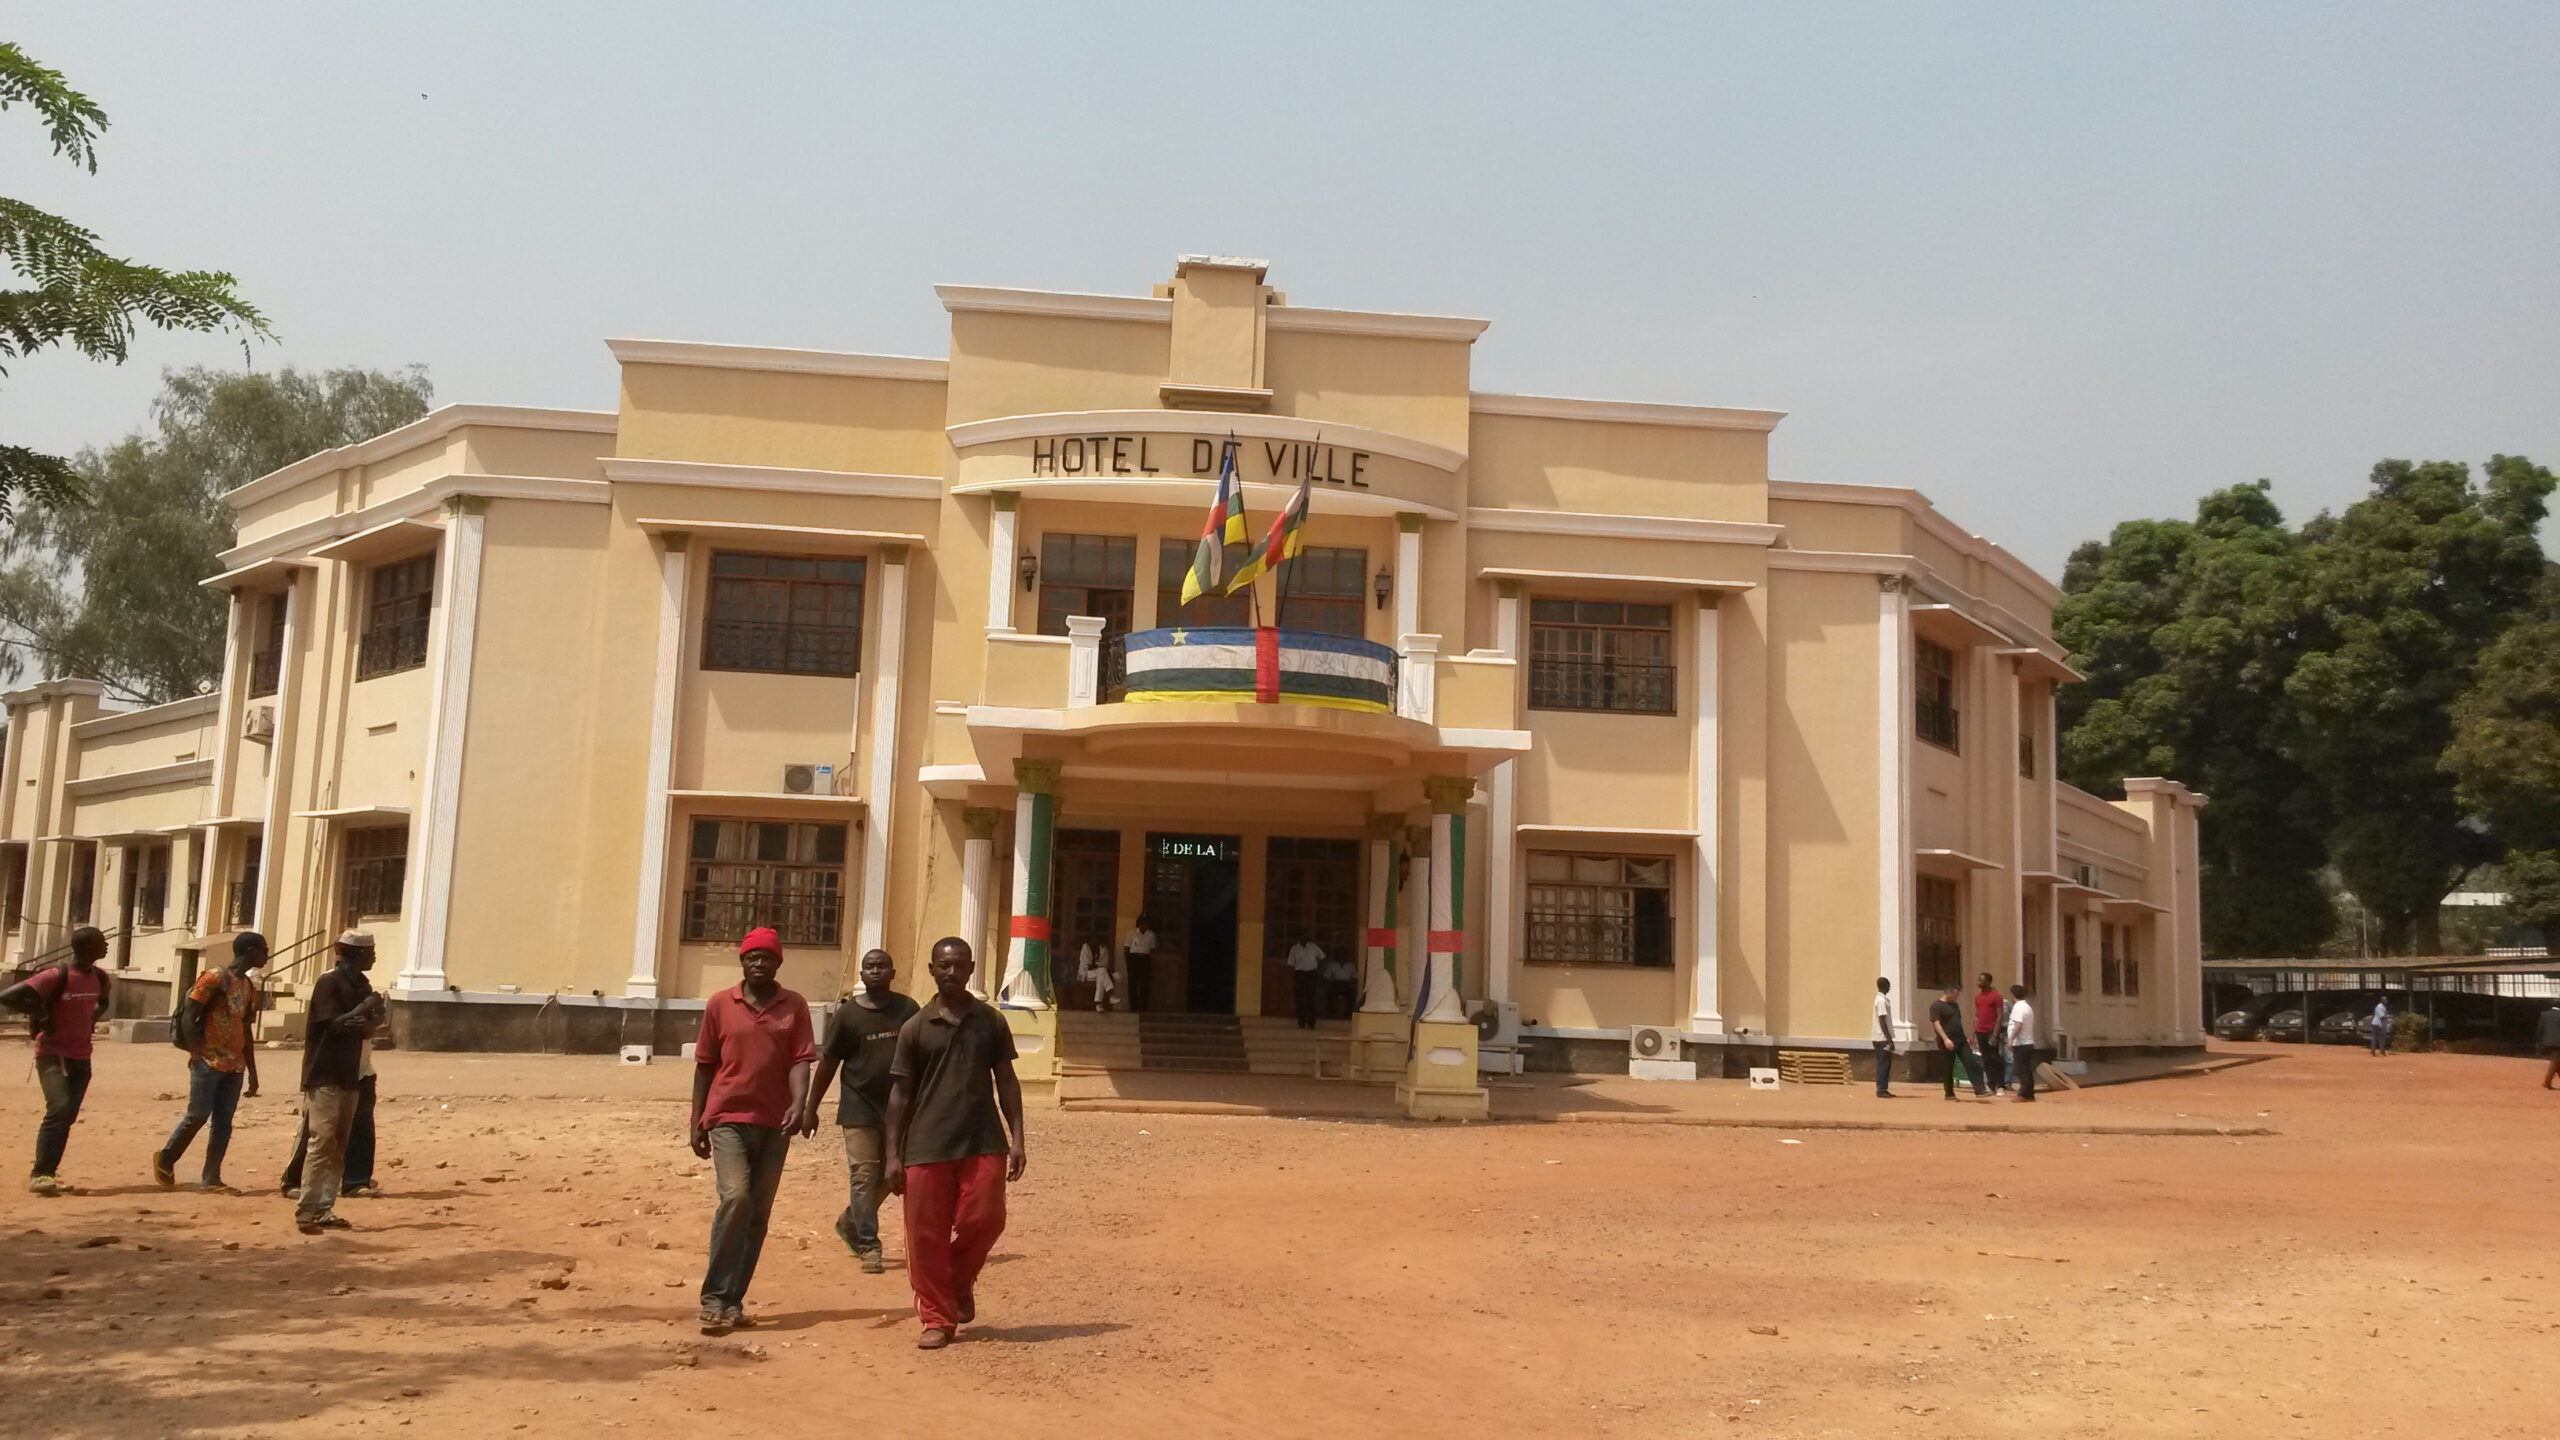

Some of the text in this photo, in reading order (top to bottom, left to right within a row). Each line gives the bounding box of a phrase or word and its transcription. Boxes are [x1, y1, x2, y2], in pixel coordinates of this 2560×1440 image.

[1033, 437, 1159, 473] HOTEL
[1265, 442, 1370, 487] VILLE
[1173, 843, 1193, 855] DE
[1196, 843, 1216, 856] LA
